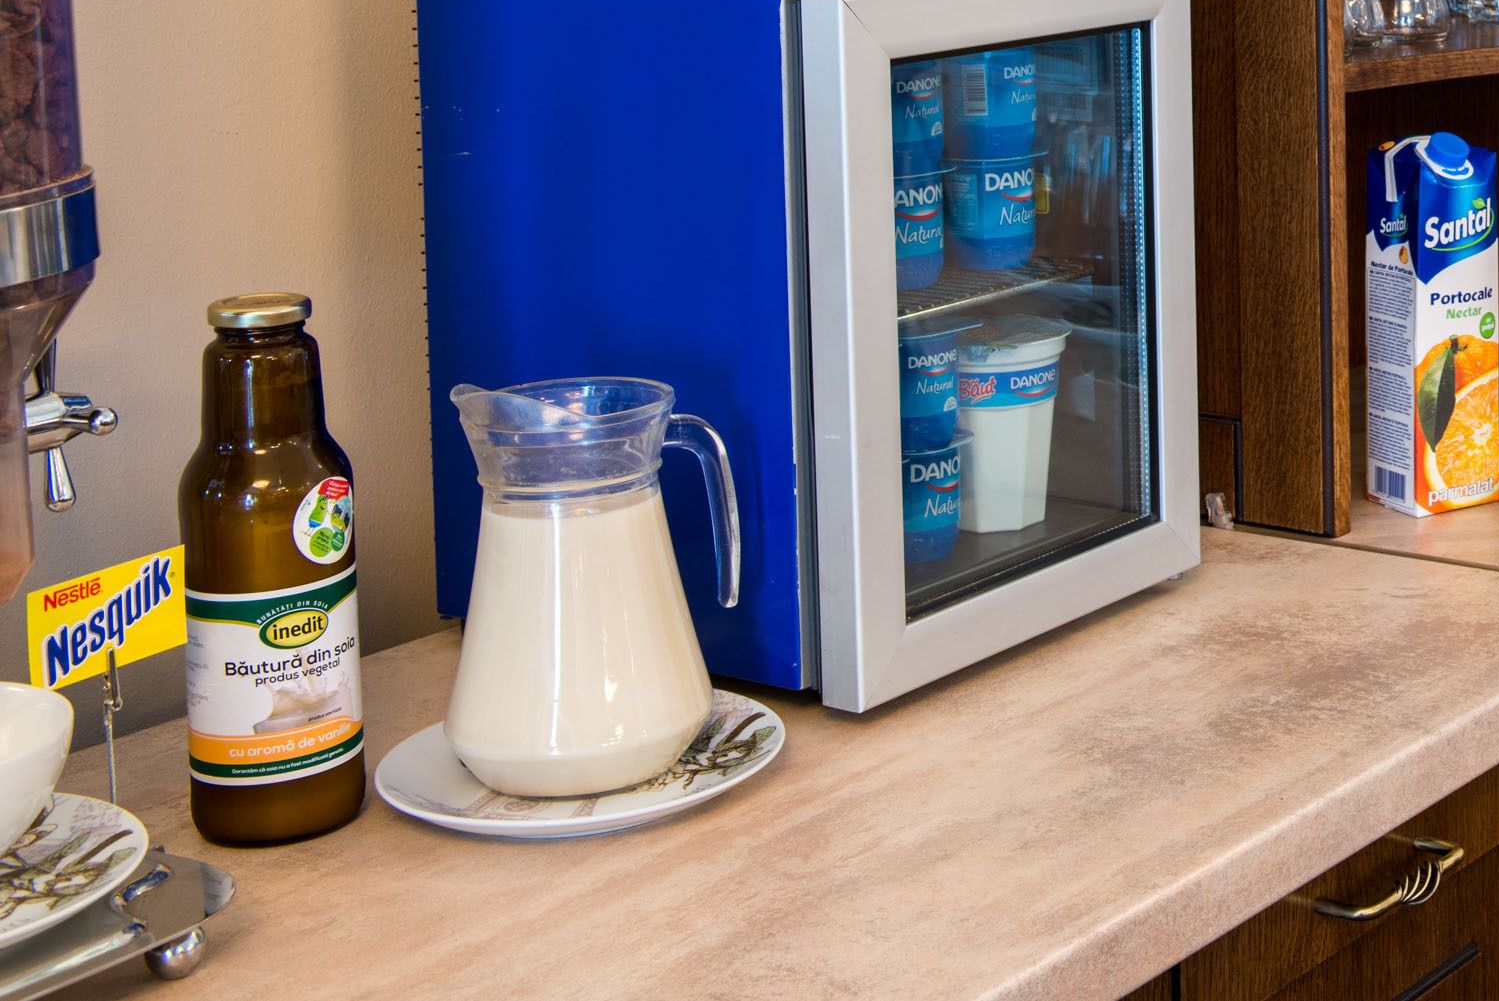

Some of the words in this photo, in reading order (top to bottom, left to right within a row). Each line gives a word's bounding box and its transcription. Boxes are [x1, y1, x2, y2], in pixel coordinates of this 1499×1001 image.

[1430, 286, 1493, 306] Portocale
[1445, 306, 1483, 320] Nectar
[1428, 477, 1495, 507] parmalat
[296, 600, 311, 608] DIN
[312, 600, 330, 610] SOIA
[46, 556, 173, 688] Nesquik
[272, 615, 325, 642] inedit
[225, 654, 303, 677] Băutură
[306, 648, 332, 666] din
[334, 636, 355, 657] soia
[255, 669, 300, 688] produs
[301, 657, 341, 678] vegetal
[228, 747, 246, 758] cu
[247, 739, 296, 757] aromă
[297, 734, 316, 749] de
[316, 722, 352, 744] vanilie
